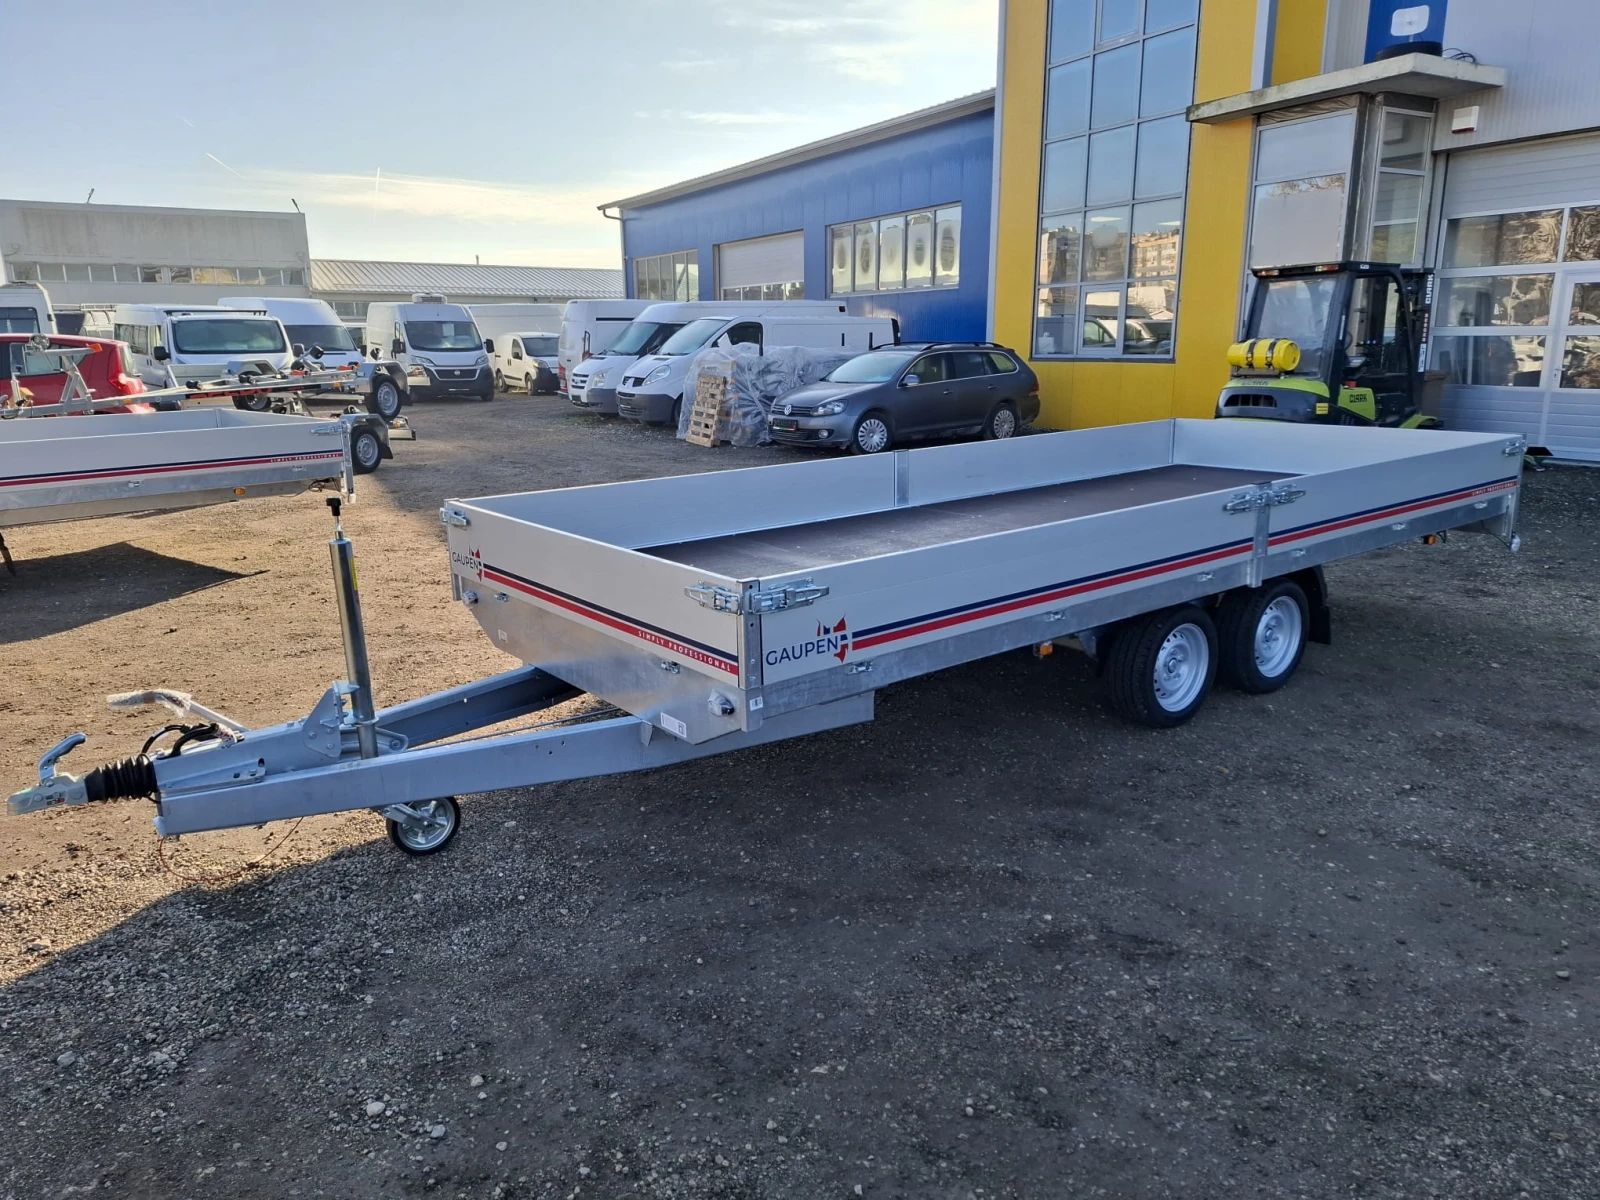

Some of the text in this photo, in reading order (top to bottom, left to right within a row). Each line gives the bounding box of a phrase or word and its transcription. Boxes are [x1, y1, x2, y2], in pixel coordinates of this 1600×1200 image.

[1425, 274, 1434, 304] CLARK
[1349, 394, 1368, 403] CLARK
[451, 551, 479, 570] GAUPEN
[638, 630, 731, 672] SIMPLY PROFESSIONAL
[766, 635, 838, 666] GAUPEN
